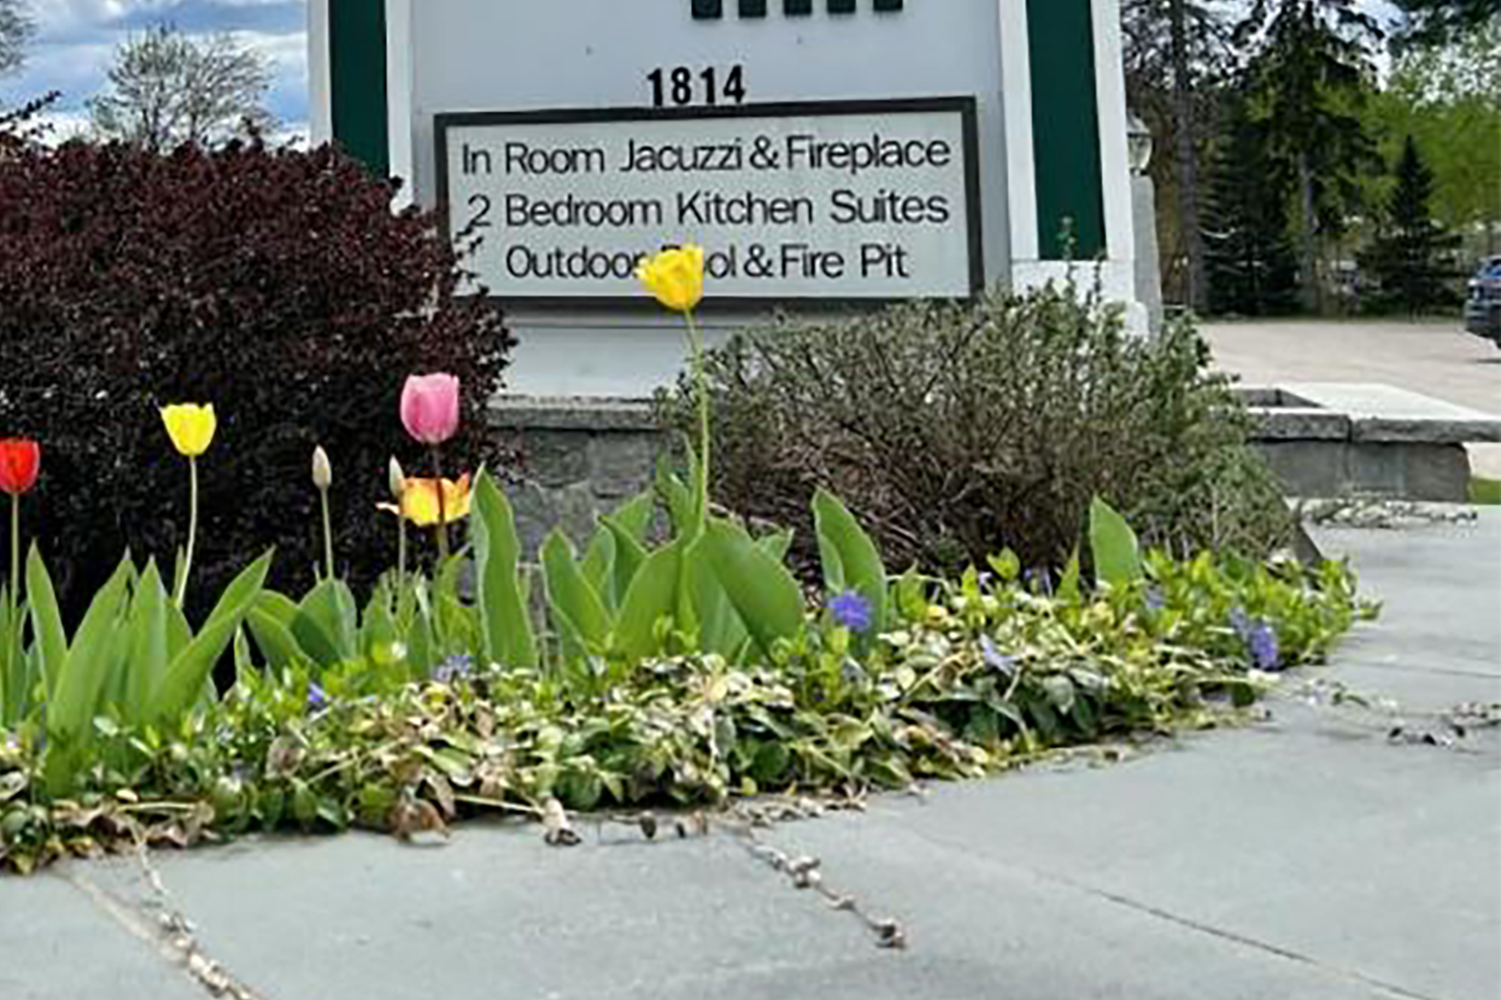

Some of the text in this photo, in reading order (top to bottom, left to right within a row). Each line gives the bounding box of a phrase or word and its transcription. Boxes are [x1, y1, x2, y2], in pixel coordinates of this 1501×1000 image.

[647, 64, 745, 106] 1814
[462, 133, 951, 174] In Room Jacuzzi & Fireplace
[468, 189, 949, 226] 2 Bedroom Kitchen Suites
[661, 244, 736, 279] ol
[743, 243, 774, 278] &
[780, 244, 845, 278] Fire
[861, 243, 909, 278] Pit
